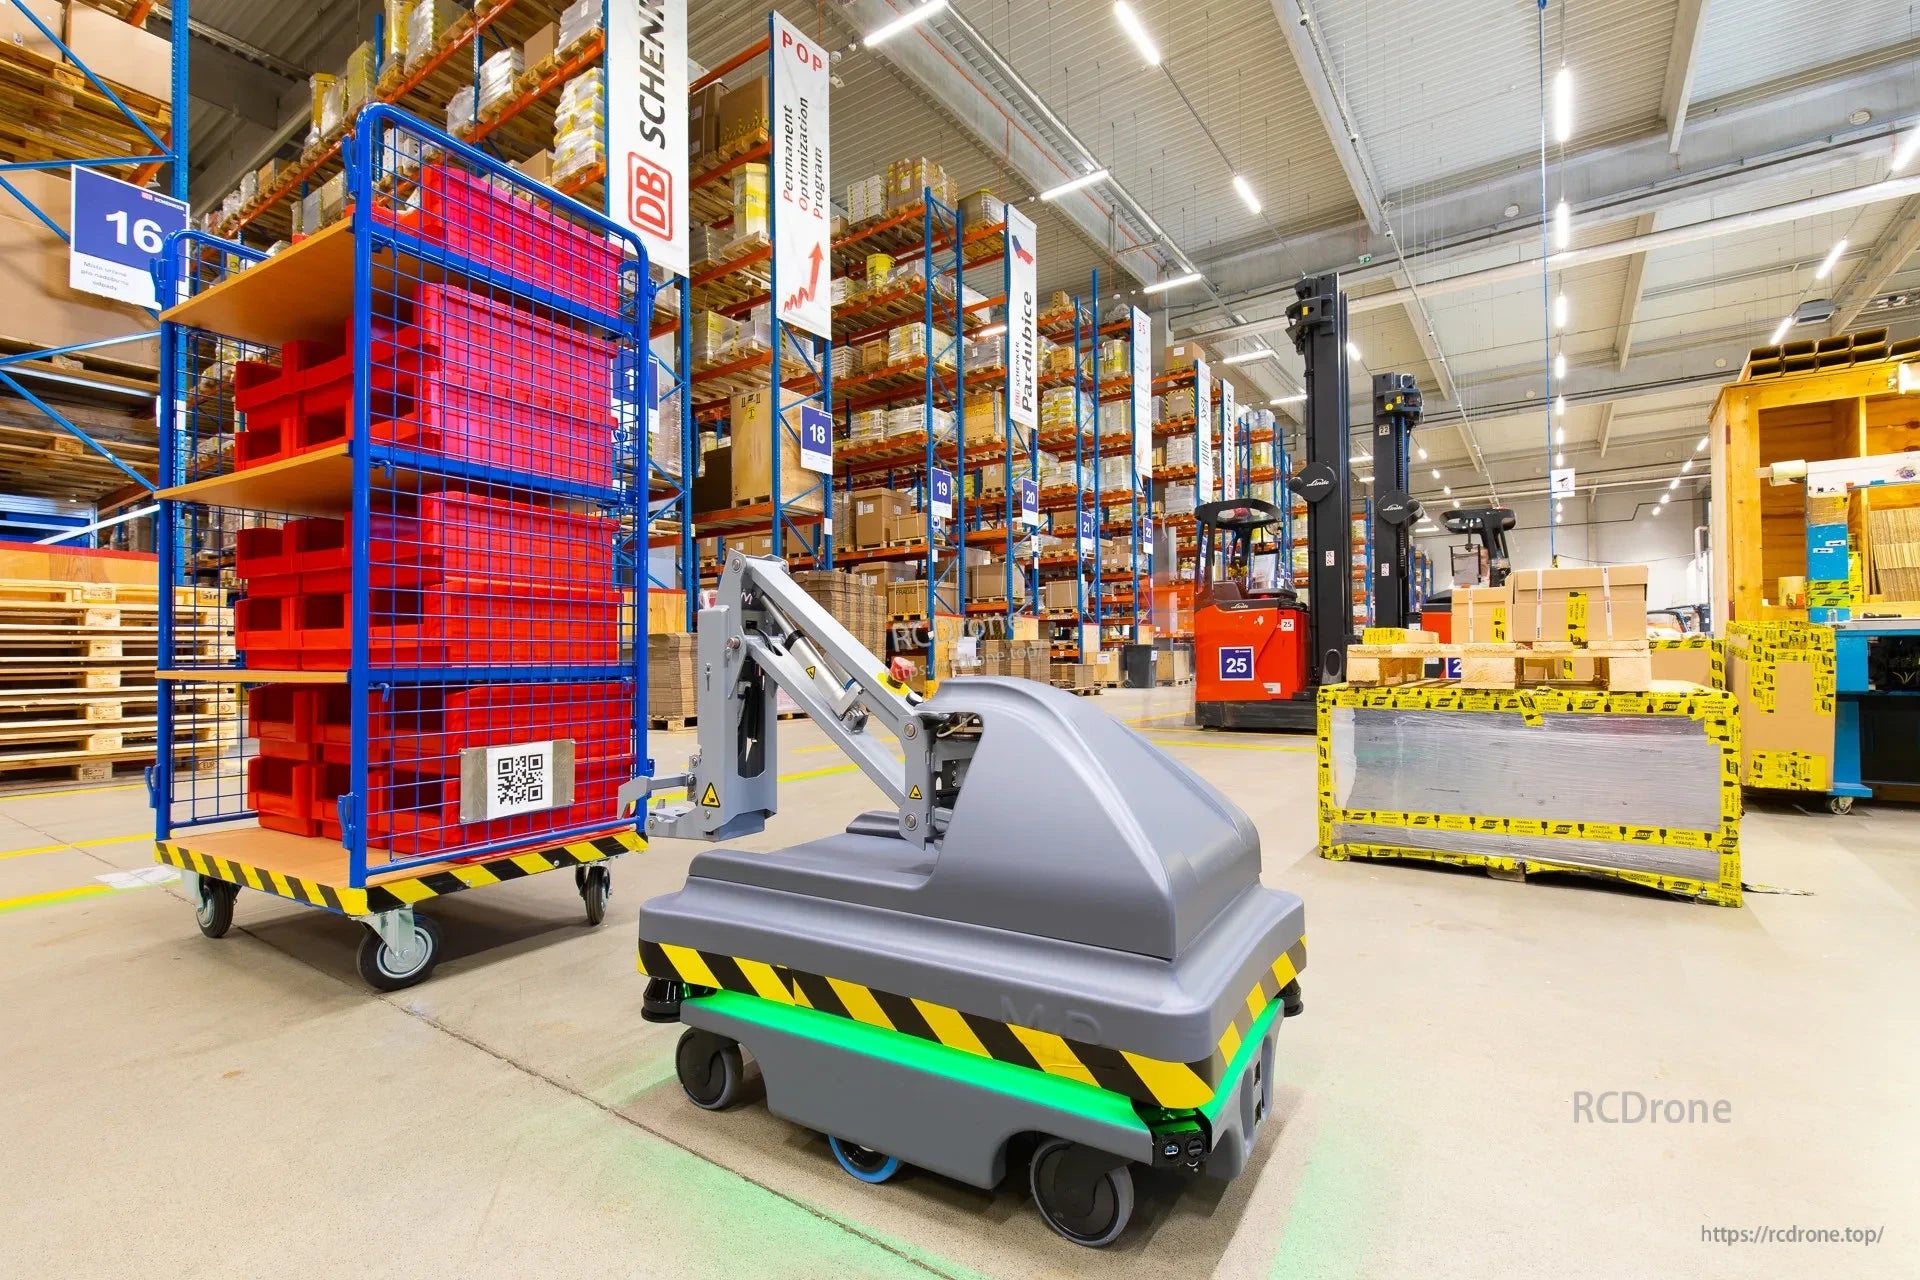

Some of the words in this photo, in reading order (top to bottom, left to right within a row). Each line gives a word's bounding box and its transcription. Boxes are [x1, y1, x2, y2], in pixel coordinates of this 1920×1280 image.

[782, 29, 822, 72] POP
[783, 104, 793, 203] Permanent
[798, 97, 810, 212] Optimization
[813, 147, 826, 220] Program
[636, 166, 665, 230] DB
[106, 211, 164, 254] 16
[1021, 291, 1032, 413] Pardubice
[809, 424, 826, 444] 18
[1380, 425, 1389, 434] 22
[936, 481, 948, 496] 19
[1306, 478, 1330, 487] Linde
[1026, 490, 1036, 505] 20
[1382, 503, 1404, 512] Linde
[1083, 521, 1090, 534] 21
[1145, 529, 1152, 539] 22
[896, 588, 918, 596] FRAGILE
[1230, 602, 1249, 610] Linde
[1226, 658, 1247, 673] 25
